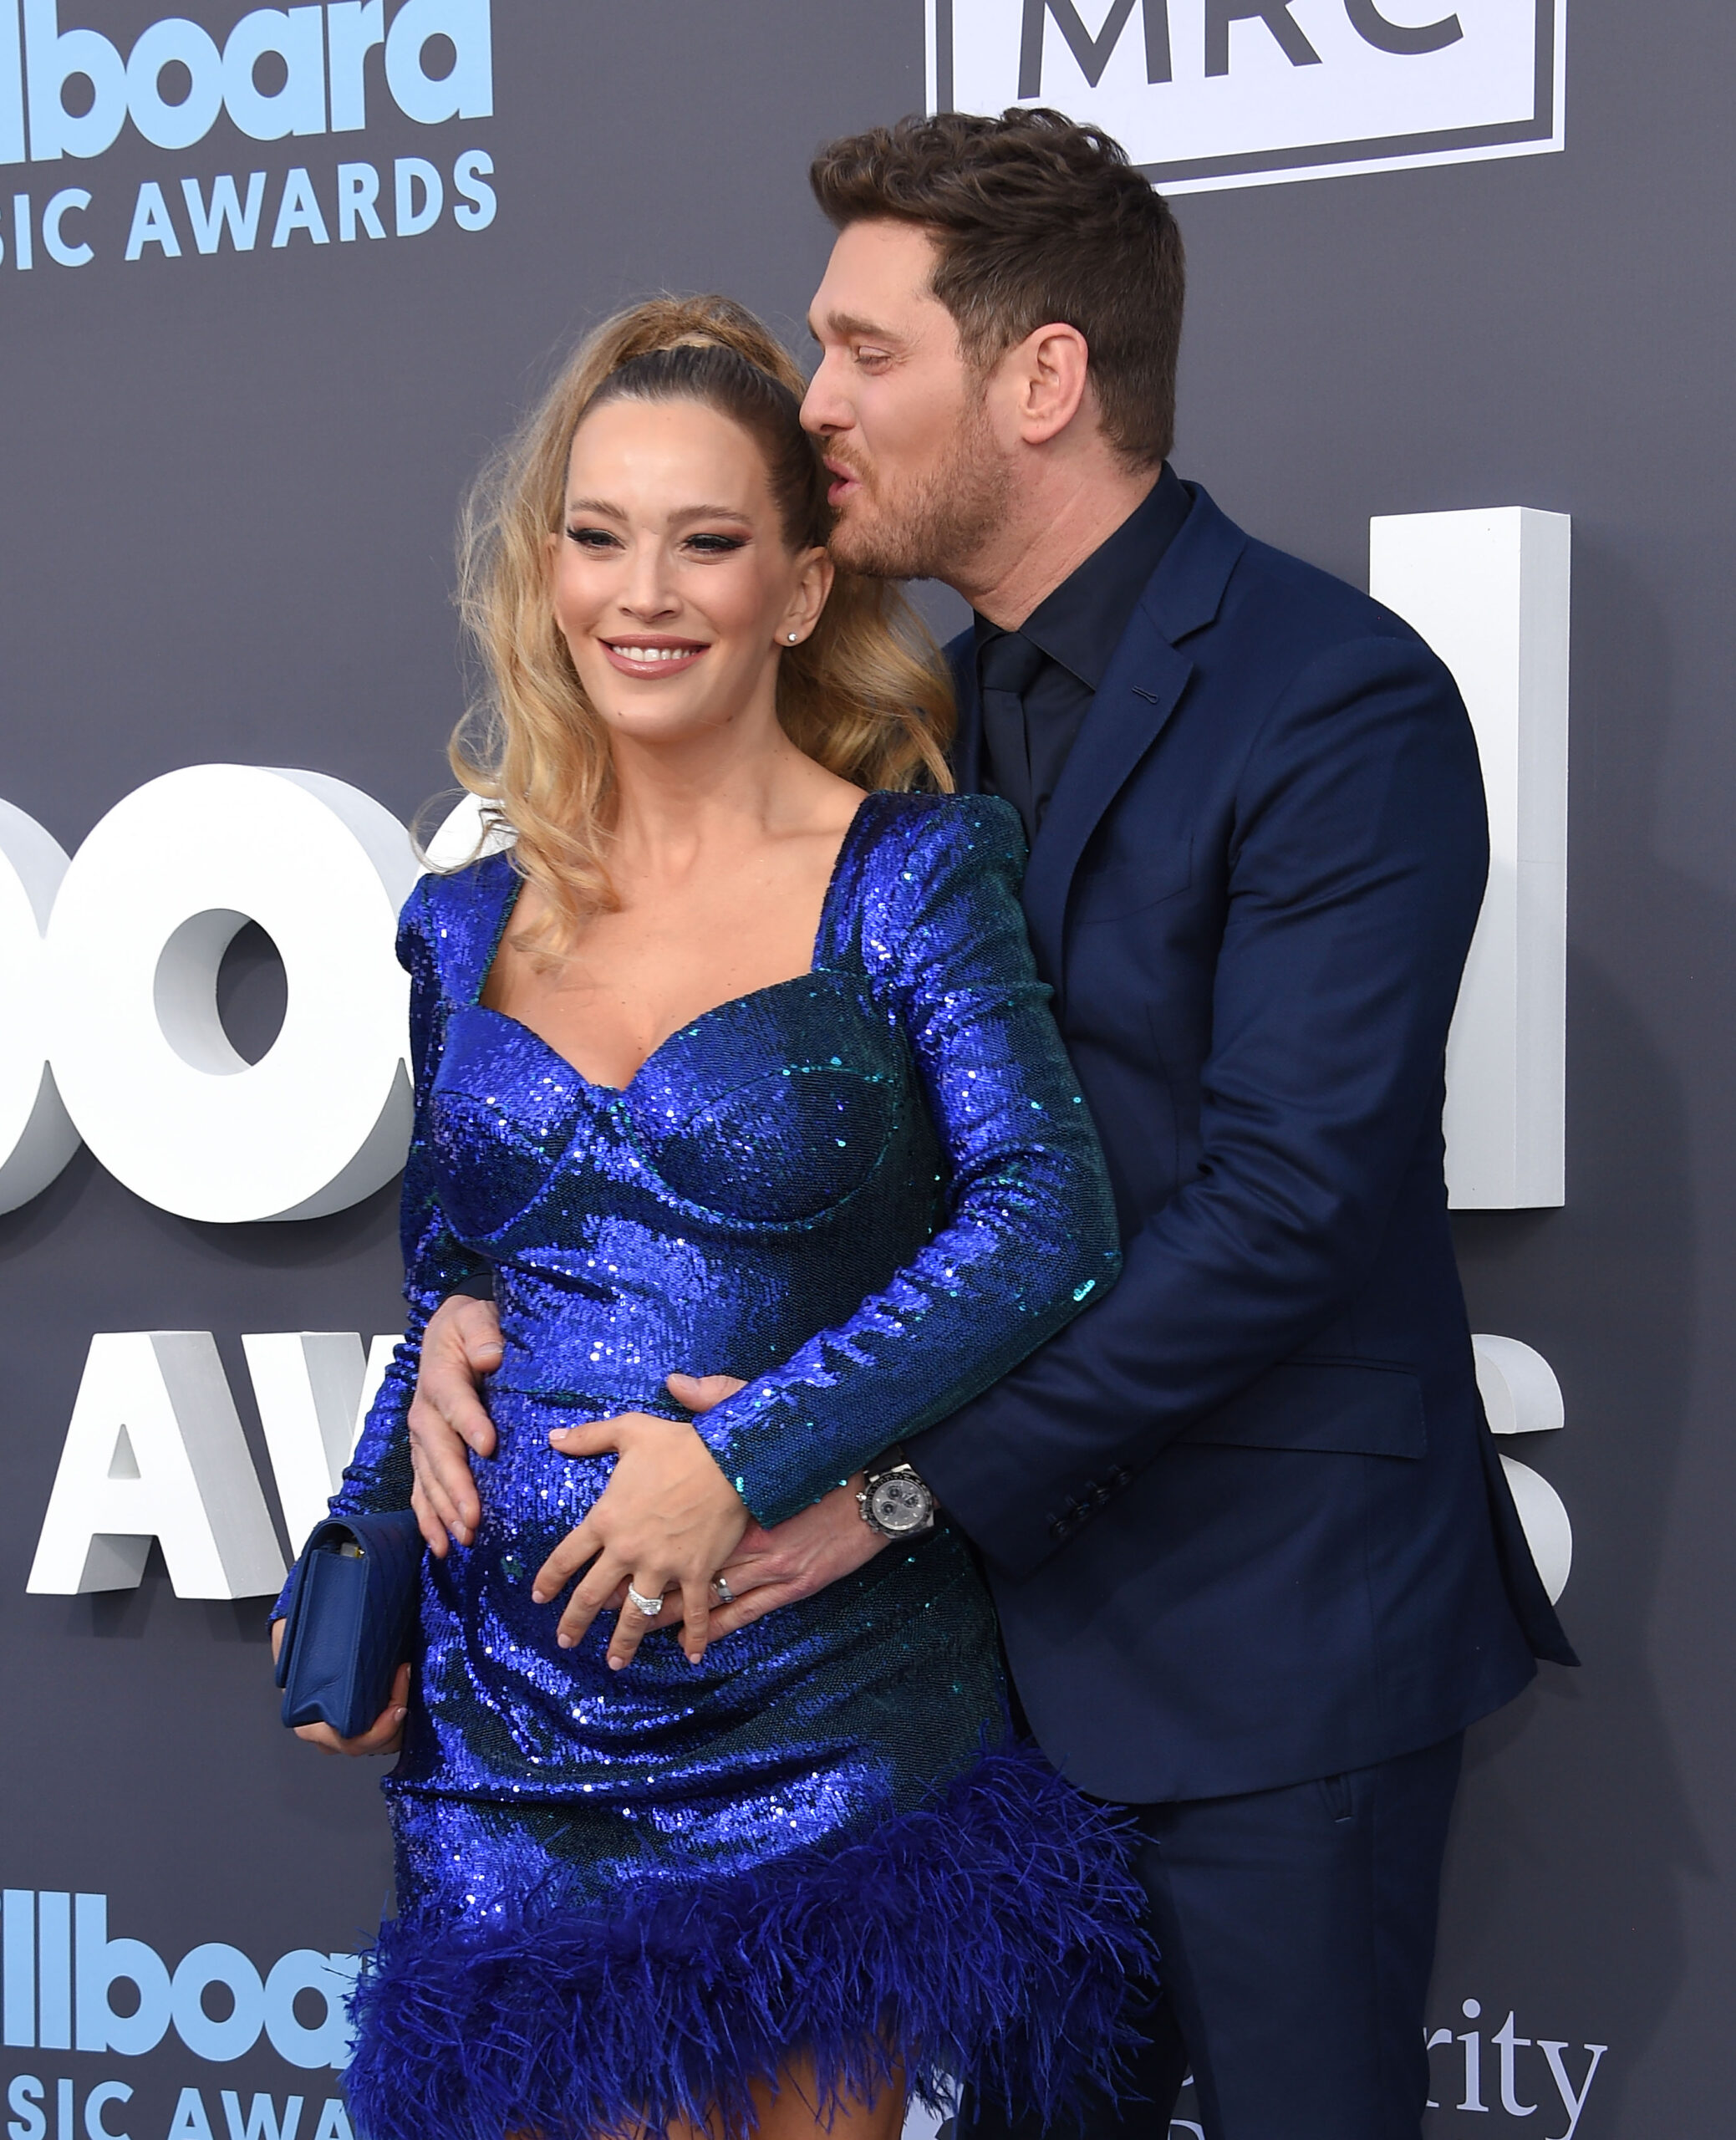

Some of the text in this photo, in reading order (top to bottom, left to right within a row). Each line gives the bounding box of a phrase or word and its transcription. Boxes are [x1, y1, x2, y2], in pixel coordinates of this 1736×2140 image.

[0, 150, 497, 270] IC AWARDS
[3, 1889, 383, 2069] llboa
[7, 2075, 134, 2140] SIC
